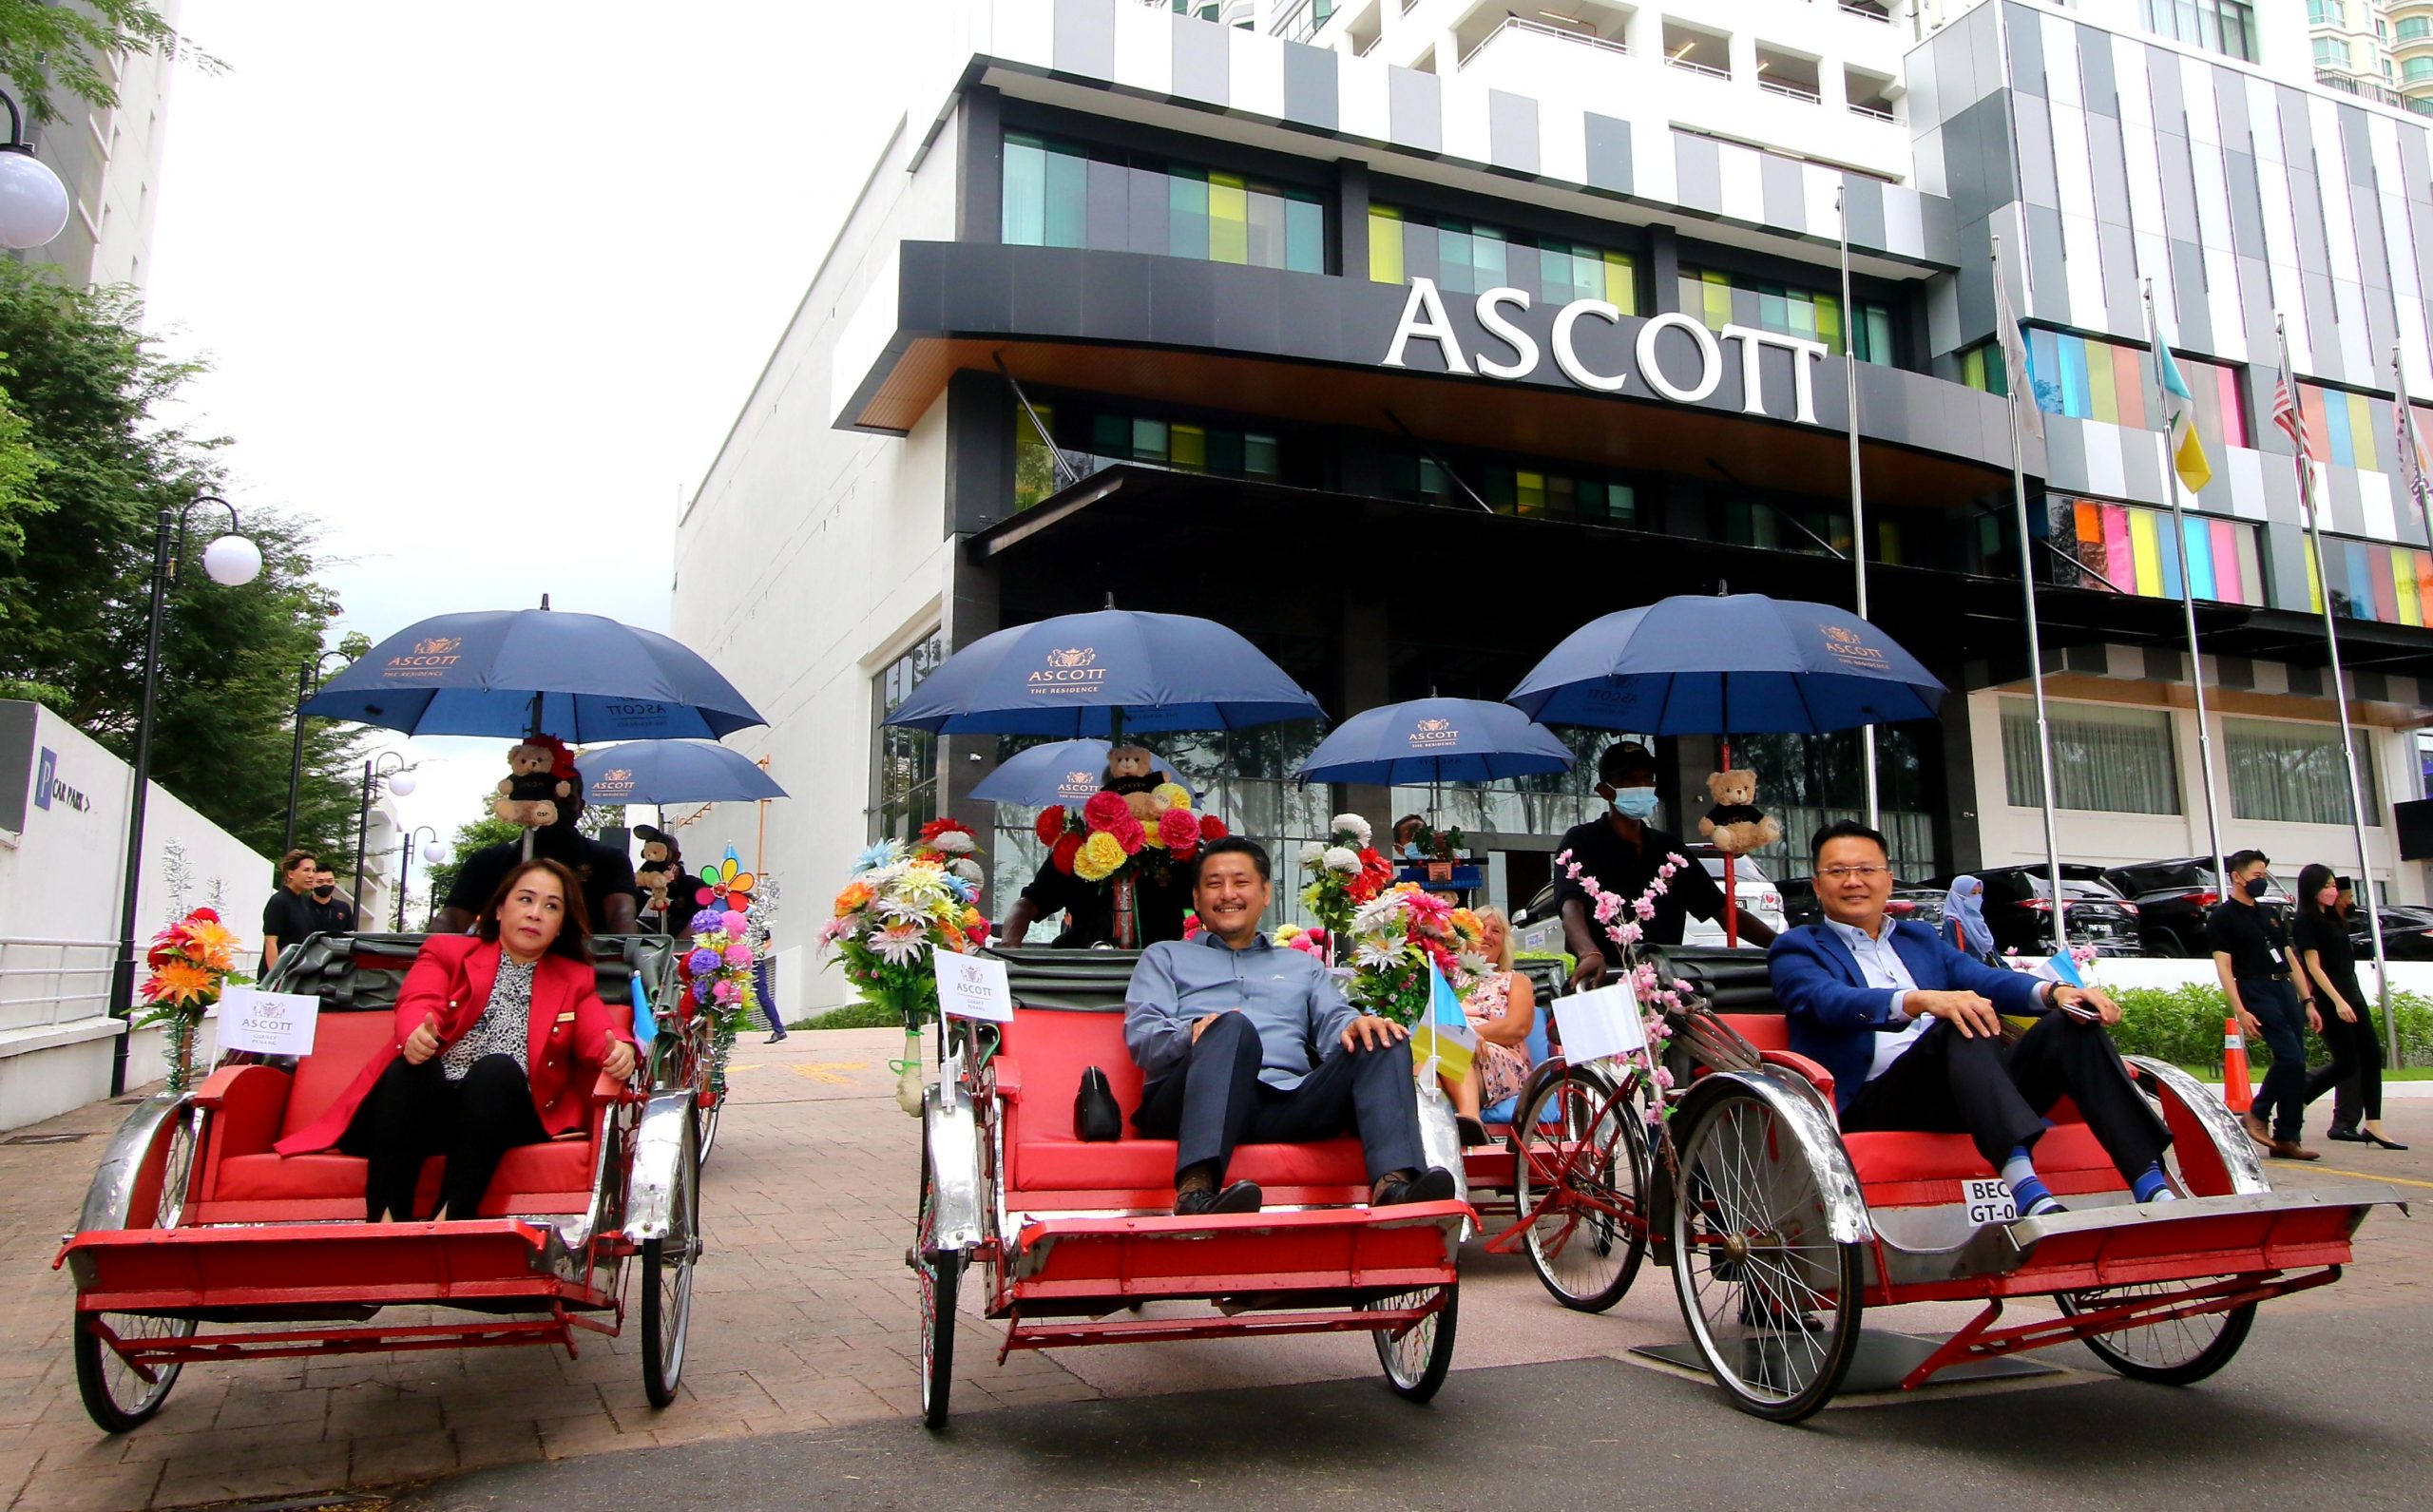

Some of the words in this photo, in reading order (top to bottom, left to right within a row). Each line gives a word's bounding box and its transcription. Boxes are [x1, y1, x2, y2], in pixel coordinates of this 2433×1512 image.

[1380, 276, 1830, 425] ASCOTT
[1826, 642, 1883, 659] ASCOTT
[387, 655, 462, 666] ASCOTT
[1028, 668, 1107, 681] ASCOTT
[1050, 686, 1099, 695] RESIDENCE
[1408, 731, 1460, 740] ASCOTT
[52, 777, 66, 803] CAR
[592, 781, 636, 790] ASCOTT
[1057, 783, 1103, 793] ASCOTT
[956, 982, 993, 997] ASCOTT
[241, 1018, 293, 1031] ASCOTT
